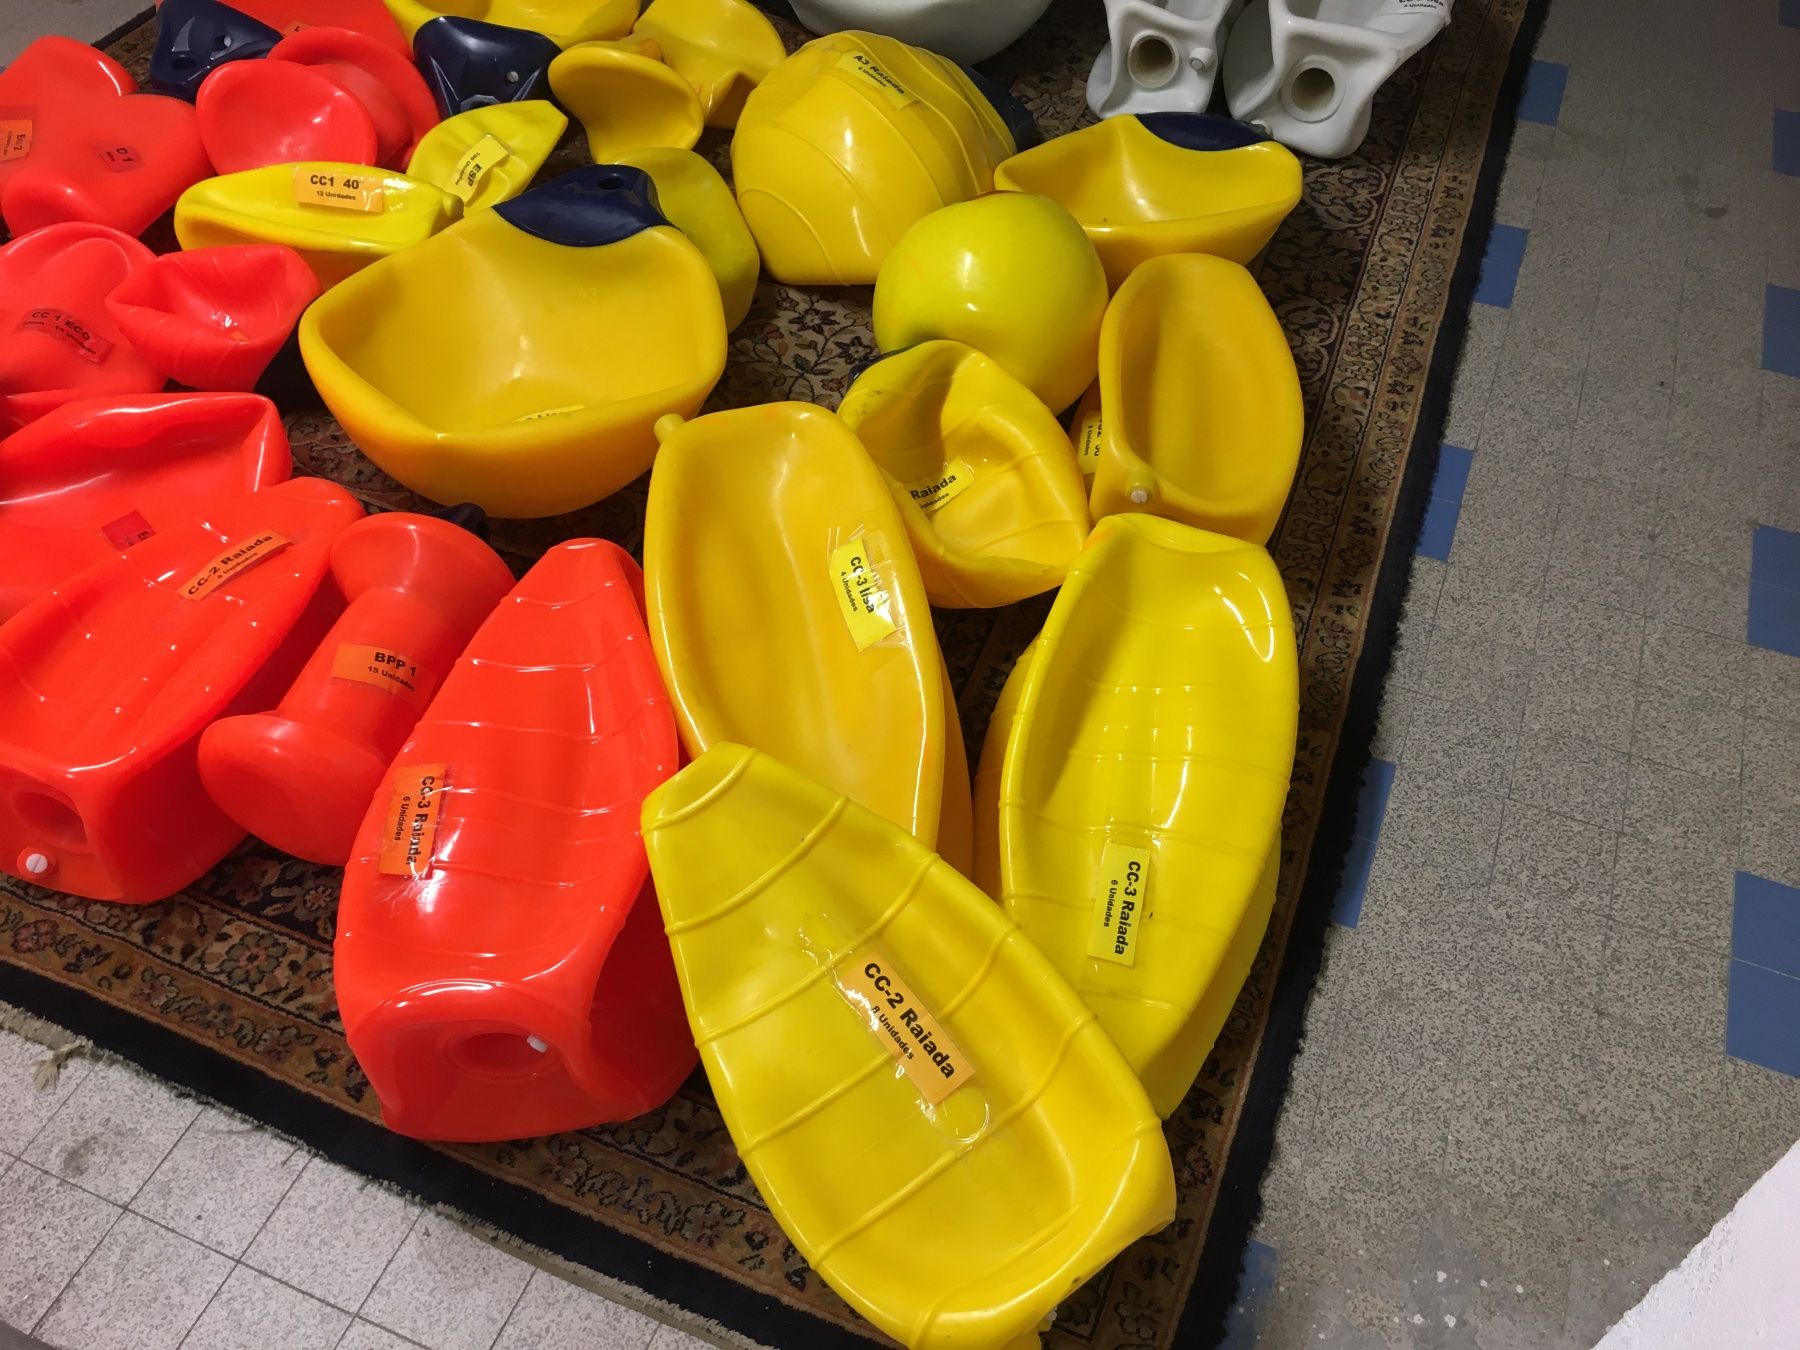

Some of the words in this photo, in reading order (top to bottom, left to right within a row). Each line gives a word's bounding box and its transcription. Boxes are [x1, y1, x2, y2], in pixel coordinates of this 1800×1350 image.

[854, 55, 870, 65] A3
[870, 66, 904, 94] Raiada
[310, 174, 334, 187] CC1
[467, 163, 482, 187] ESP
[325, 190, 356, 201] Unidades
[64, 320, 90, 341] ECO
[910, 475, 956, 500] Raiada
[188, 566, 220, 595] CC-2
[220, 536, 273, 565] Raiada
[850, 556, 868, 587] CC-3
[842, 577, 858, 612] Unidades
[368, 666, 378, 674] 15
[374, 651, 406, 669] BPP
[409, 666, 416, 677] 1
[417, 776, 435, 809] CC-3
[394, 803, 409, 841] Unidades
[406, 813, 429, 865] Raiada
[1124, 861, 1141, 897] CC-3
[1104, 887, 1117, 928] Unidades
[1114, 900, 1135, 955] Raiada
[864, 962, 904, 1010] CC-2
[899, 1008, 955, 1079] Raiada
[879, 1013, 914, 1060] Unidades
